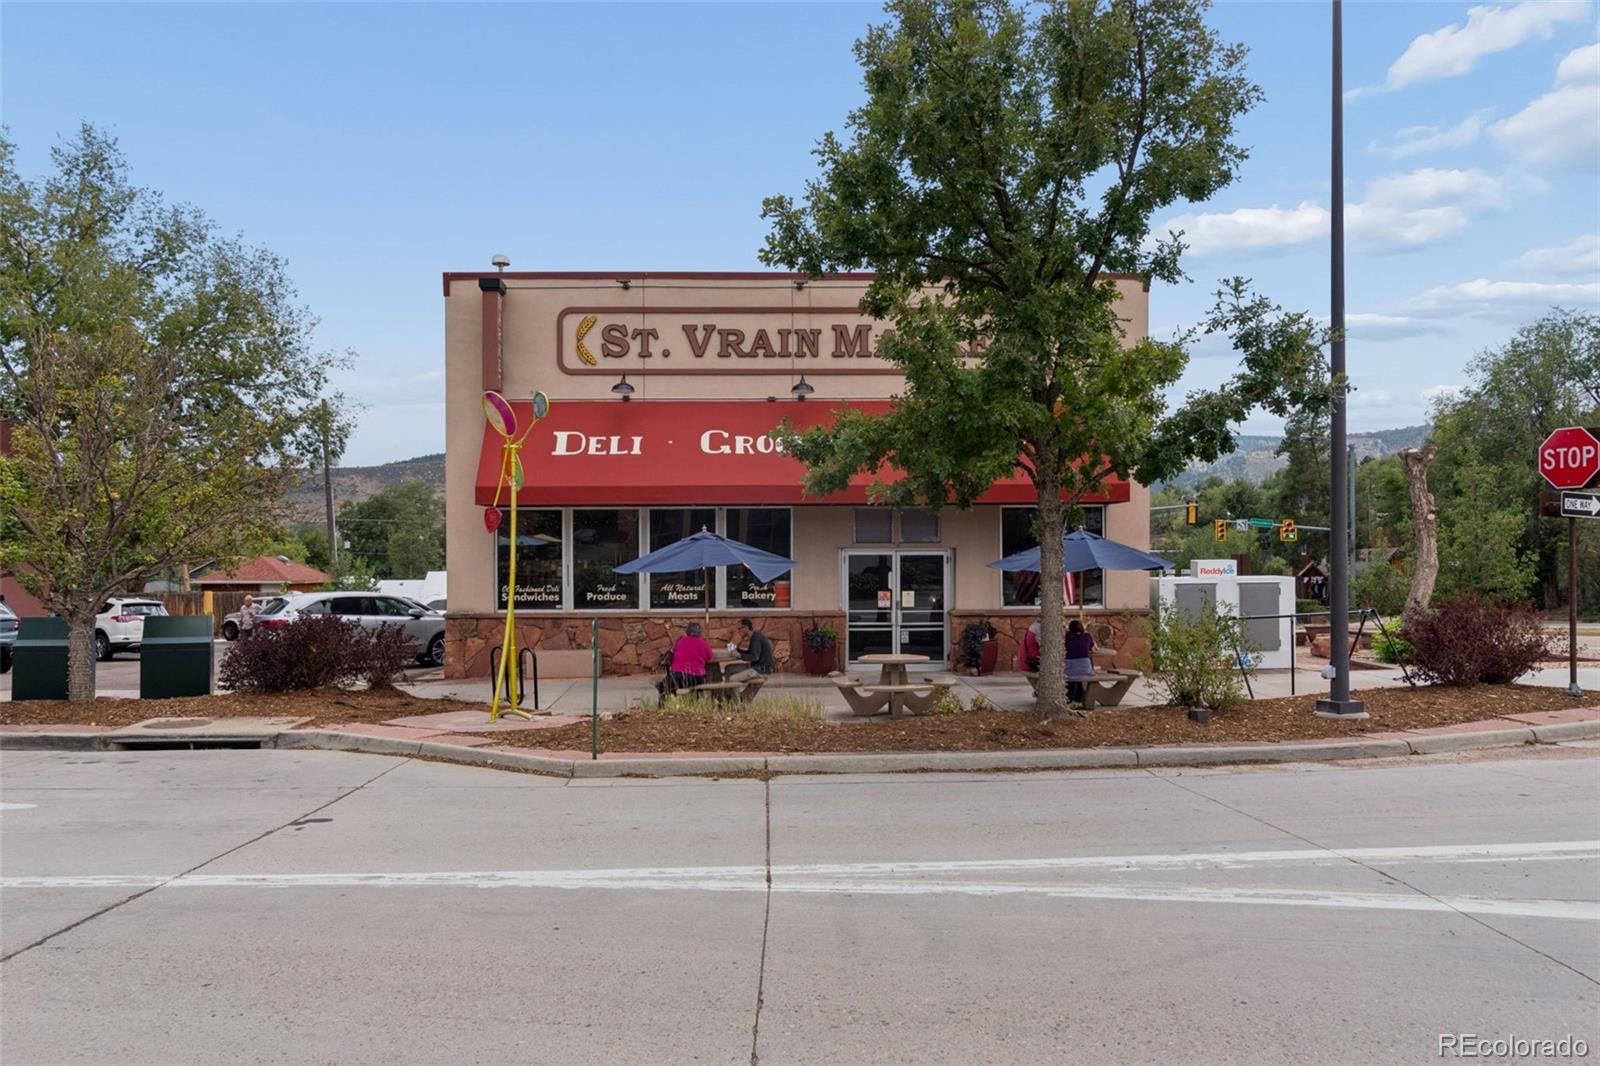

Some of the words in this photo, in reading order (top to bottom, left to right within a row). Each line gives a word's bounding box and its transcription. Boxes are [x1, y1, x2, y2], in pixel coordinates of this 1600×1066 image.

[601, 324, 671, 358] ST.
[681, 324, 822, 358] VRAIN
[552, 431, 643, 455] DELI
[1543, 445, 1596, 470] STOP
[1566, 499, 1579, 509] ONE
[1580, 500, 1592, 510] WAY
[660, 583, 675, 592] All
[675, 583, 707, 592] Natural
[501, 592, 560, 601] Sndwiches
[586, 591, 627, 601] Produce
[668, 591, 699, 601] Meats
[741, 590, 777, 602] Bakery
